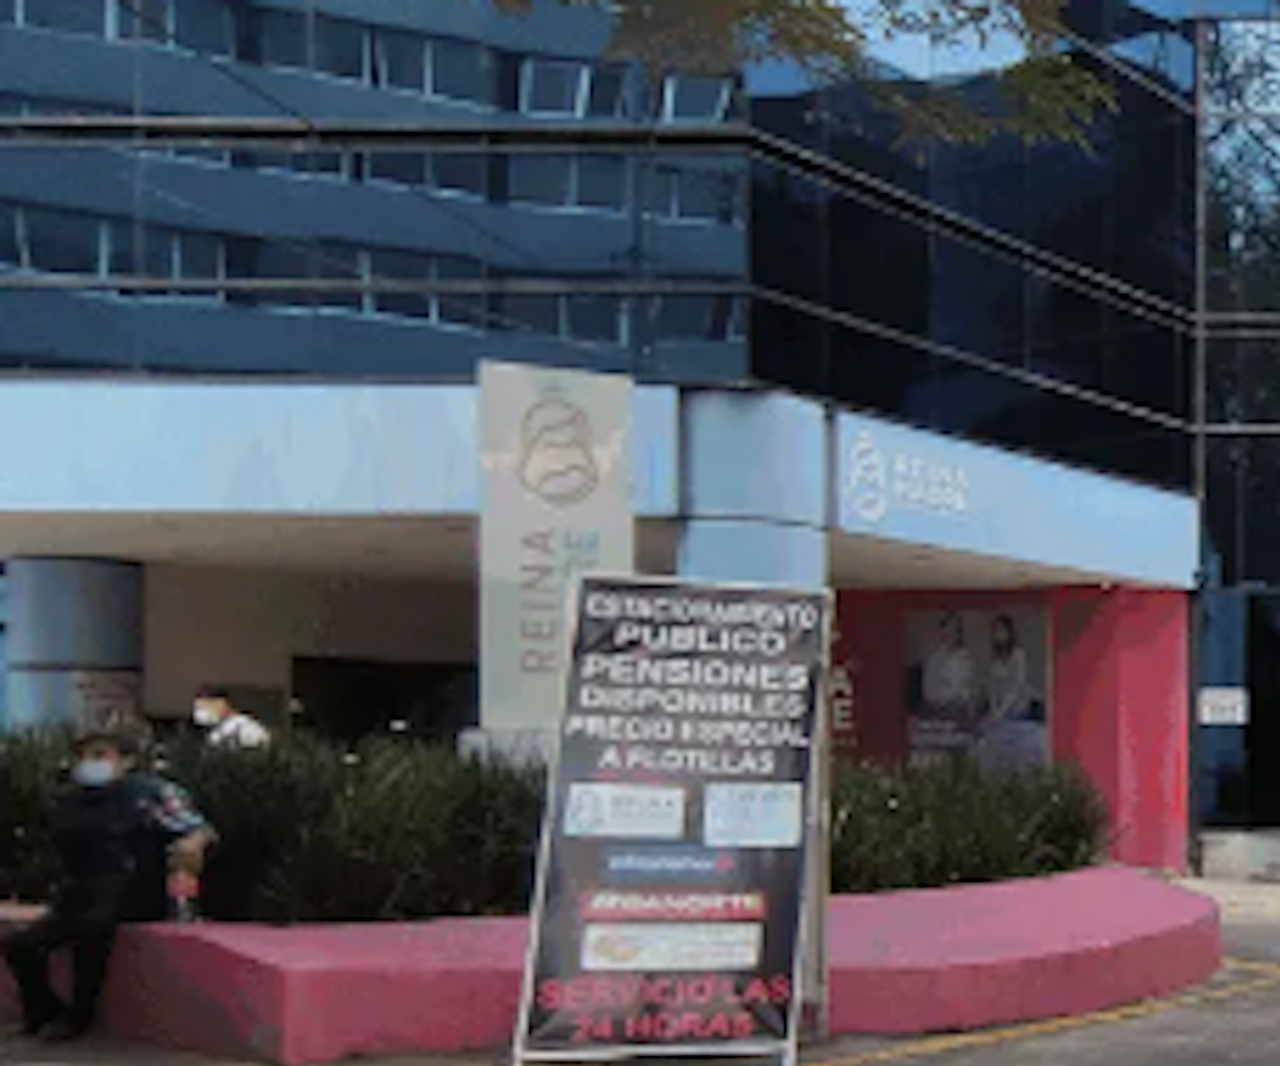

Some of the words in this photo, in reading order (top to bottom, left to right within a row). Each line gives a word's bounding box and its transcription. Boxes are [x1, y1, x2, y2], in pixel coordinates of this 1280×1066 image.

[521, 527, 557, 672] REINA
[614, 620, 786, 654] PUBLICO
[580, 652, 808, 690] PENSIONES
[580, 684, 806, 718] DISPONIBLES
[565, 714, 674, 741] PRECIO
[680, 719, 811, 748] ESPECIAL
[598, 746, 621, 768] A
[626, 745, 775, 774] FLOTILLAS
[537, 973, 716, 1011] SERVICIO
[720, 972, 791, 1002] LAS
[570, 1012, 613, 1043] 24
[624, 1010, 753, 1040] HORAS
